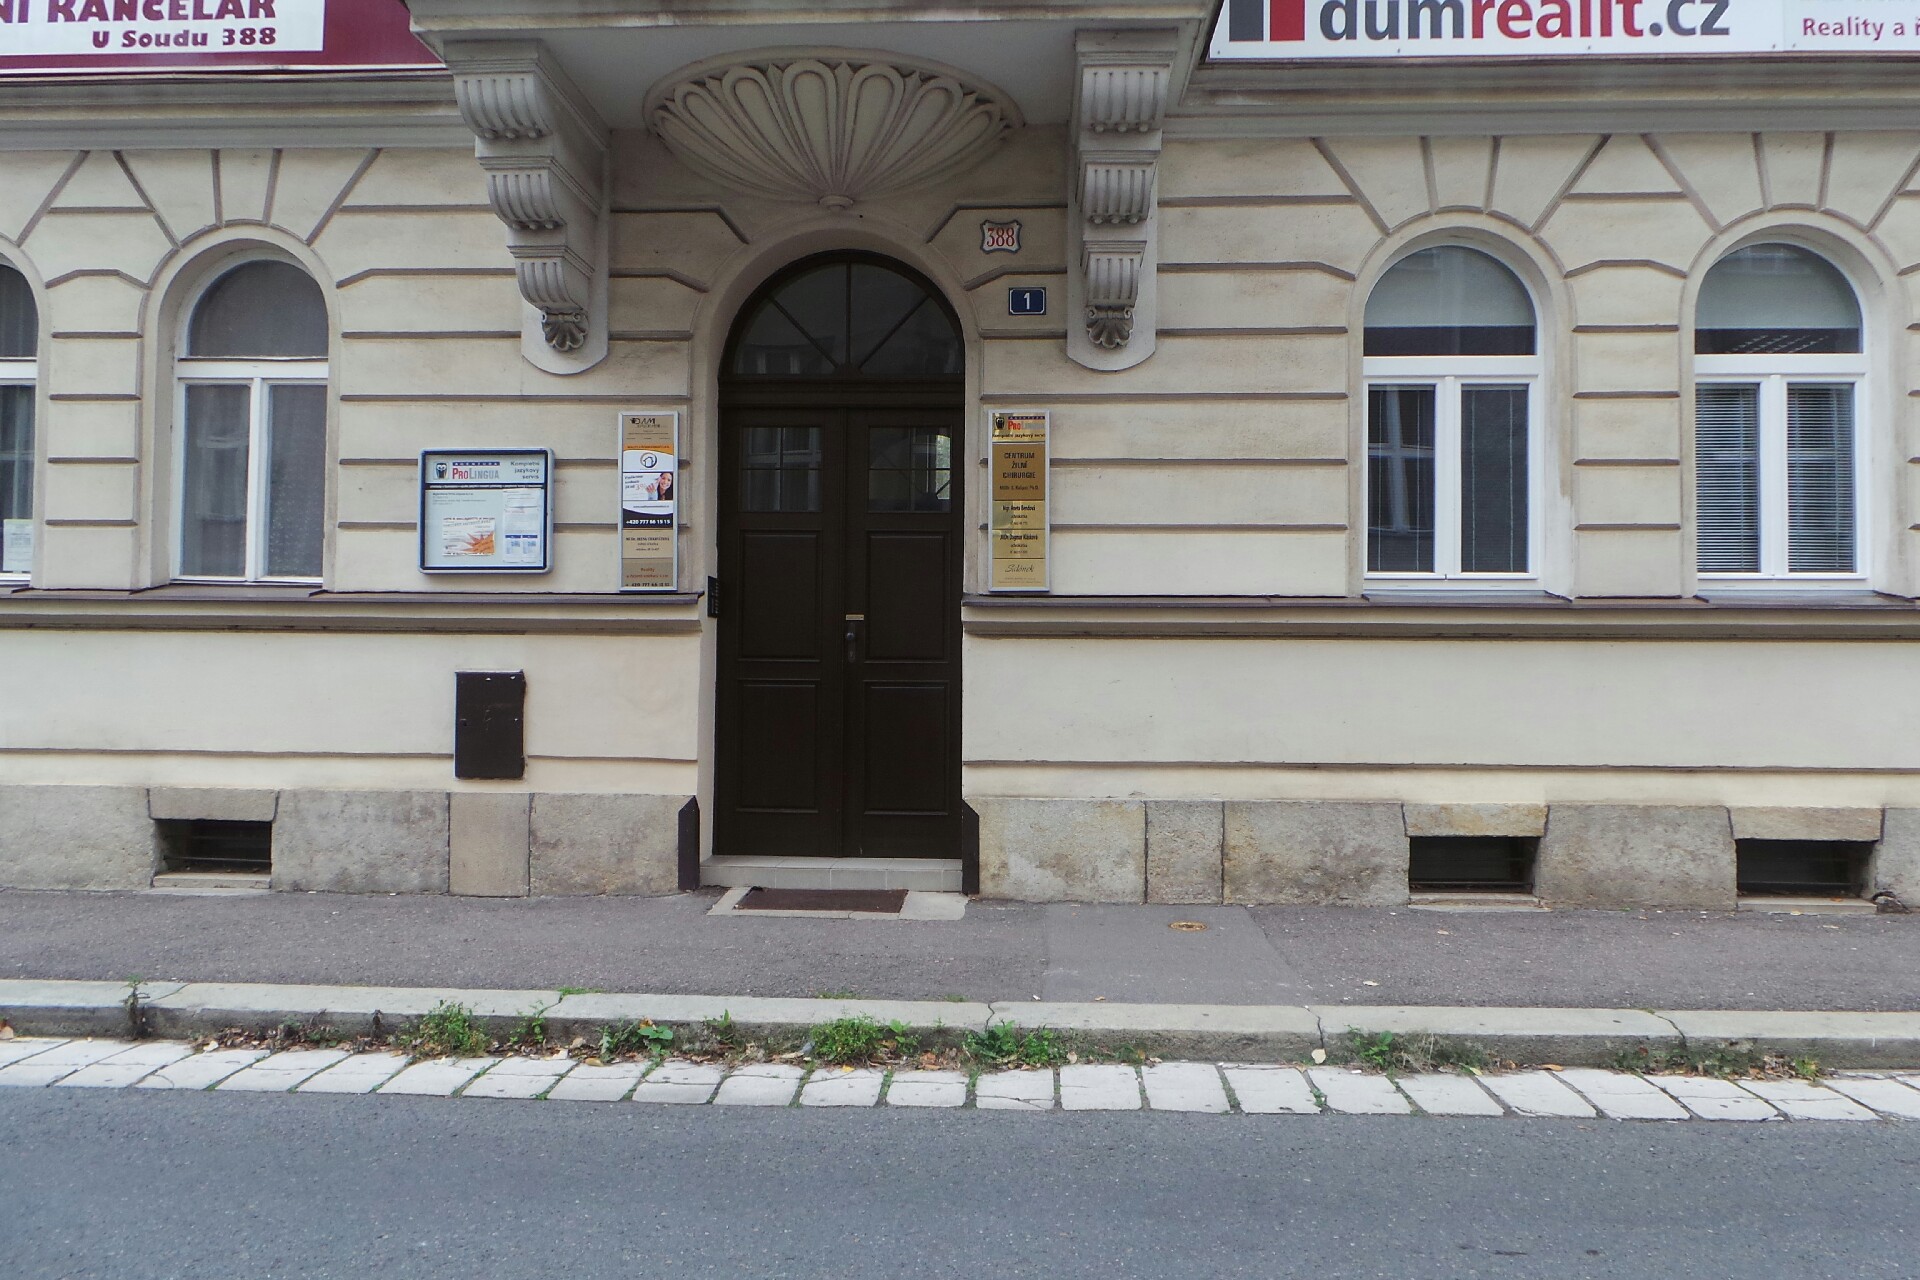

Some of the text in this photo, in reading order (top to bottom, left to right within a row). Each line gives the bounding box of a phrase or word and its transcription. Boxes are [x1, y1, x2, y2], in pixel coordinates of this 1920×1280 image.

[92, 27, 276, 49] U Soudu 388
[1802, 17, 1885, 41] Reality
[1892, 22, 1906, 36] a
[986, 227, 1016, 247] 388
[1023, 292, 1031, 310] 1
